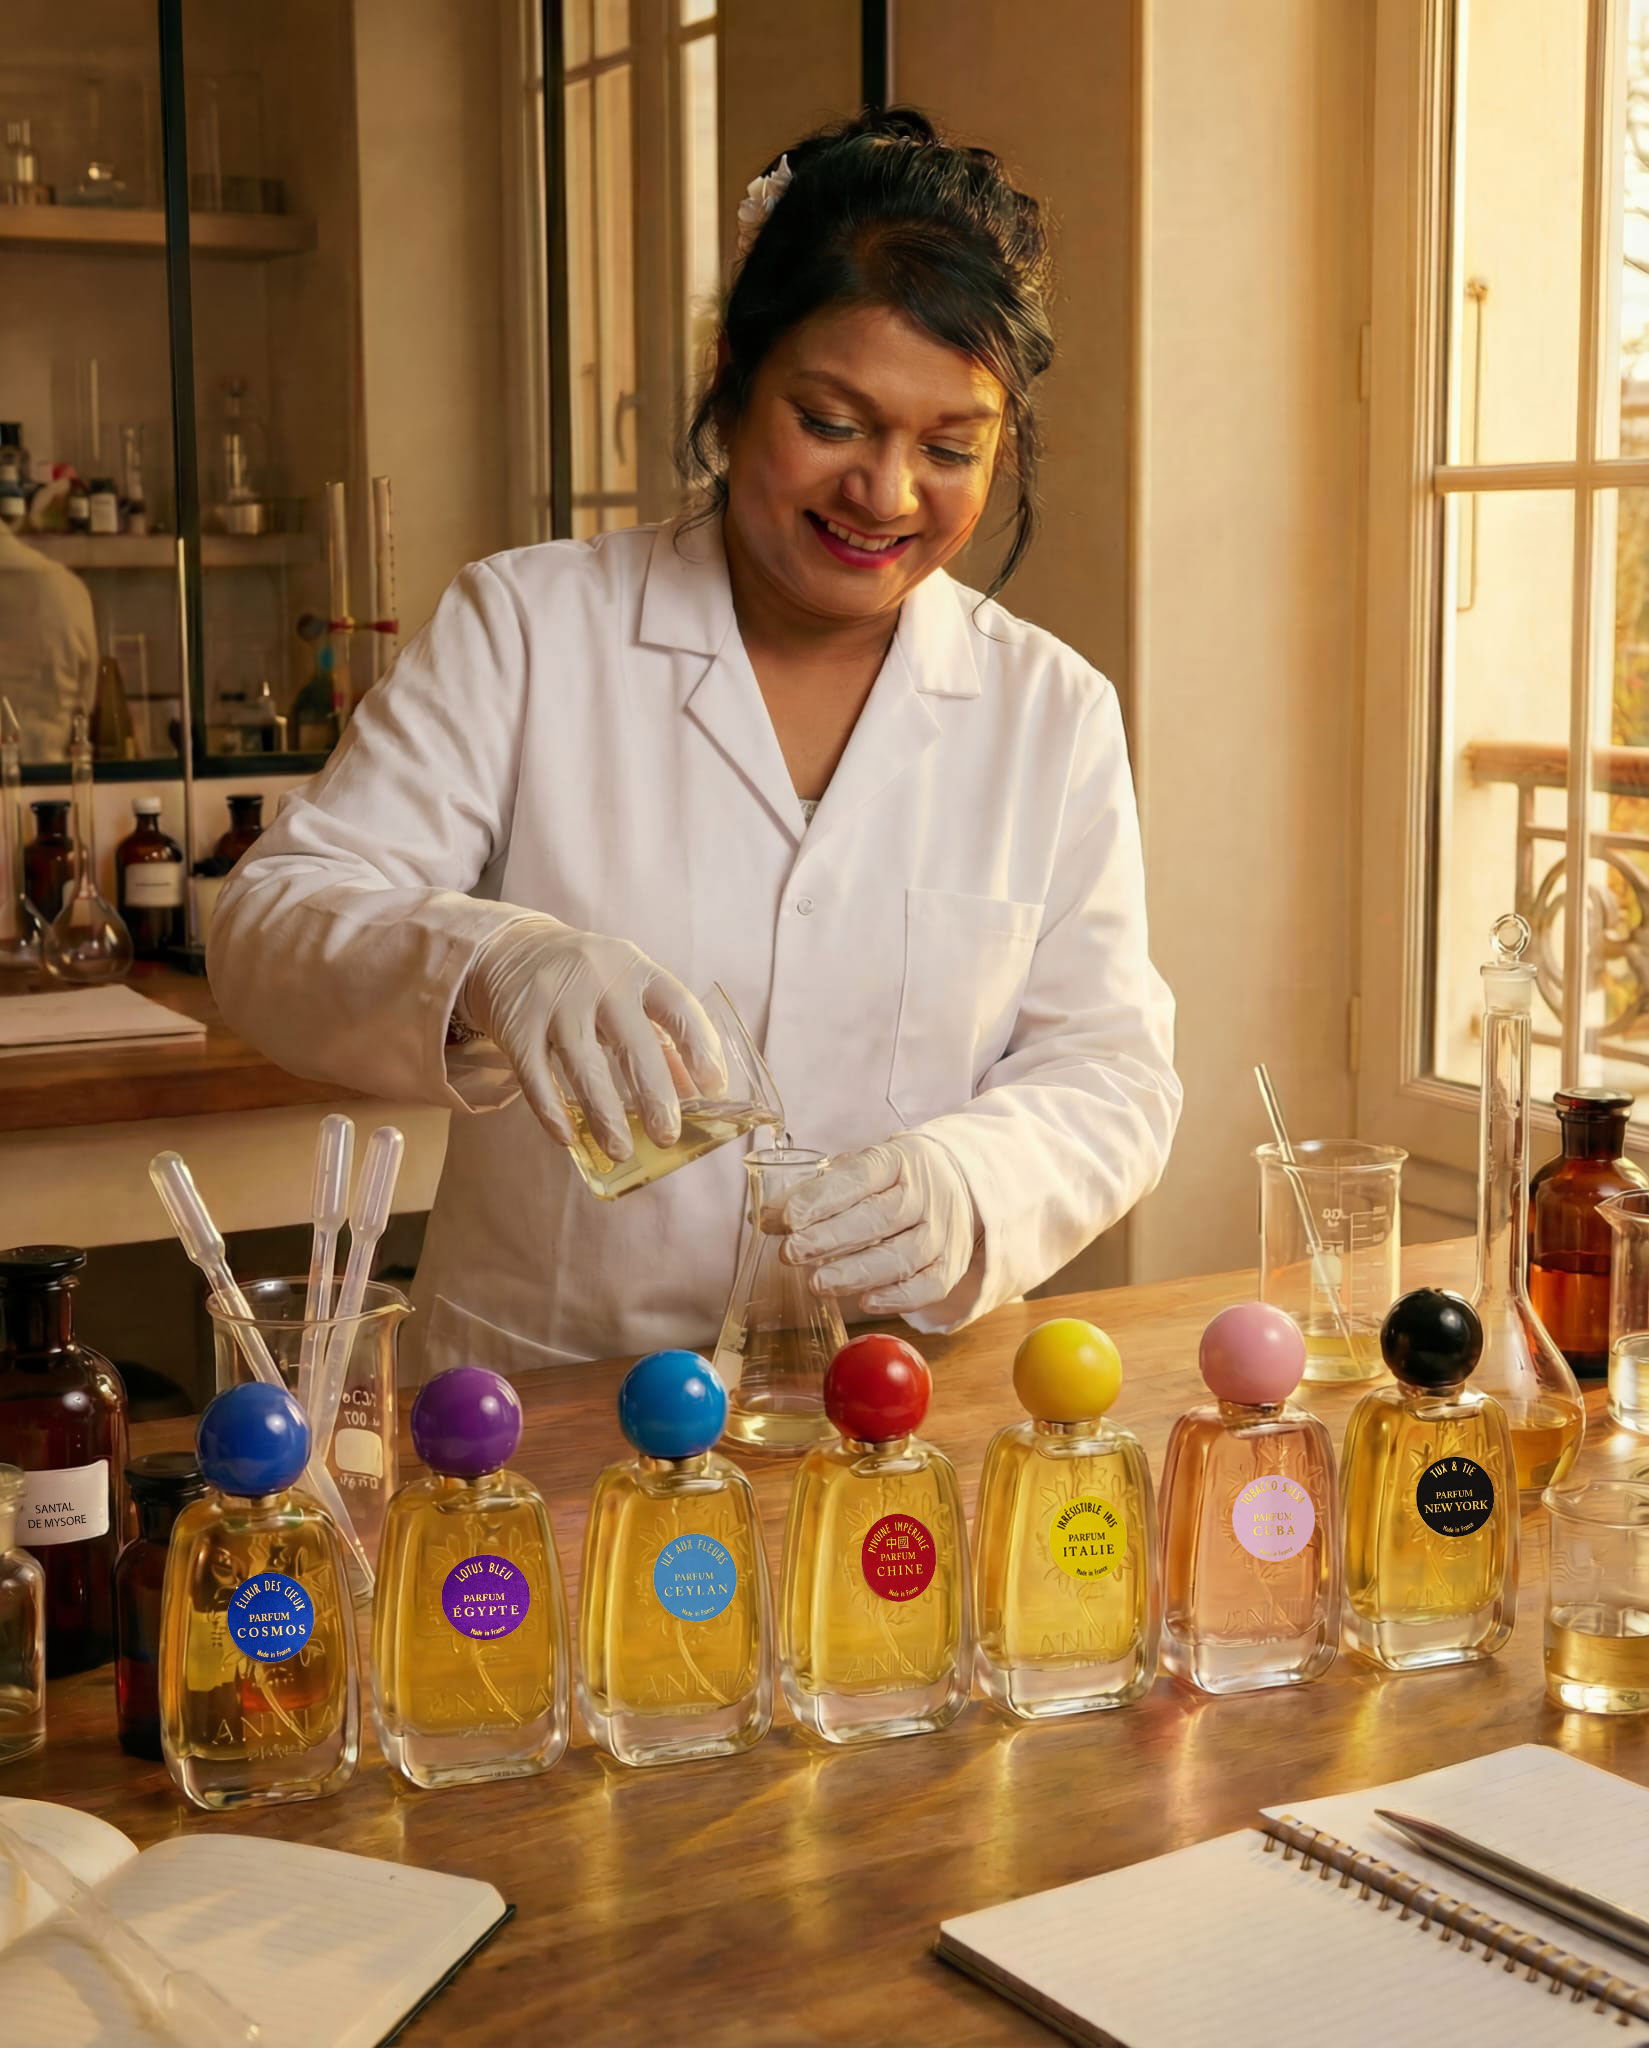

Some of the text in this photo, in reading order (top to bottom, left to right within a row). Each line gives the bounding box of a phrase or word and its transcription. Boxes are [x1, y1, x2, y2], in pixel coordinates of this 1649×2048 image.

[1430, 1461, 1476, 1478] TUX & TIE
[1241, 1480, 1305, 1505] TOBACCO SALSA
[1436, 1489, 1472, 1499] PARFUM
[35, 1502, 75, 1514] SANTAL
[1424, 1500, 1488, 1514] NEW YORK
[28, 1514, 86, 1528] DE MYSORE
[1057, 1502, 1117, 1530] IRRÉSISTIBLE IRIS
[1254, 1512, 1292, 1522] PARFUM
[1253, 1525, 1296, 1536] CUBA
[868, 1522, 929, 1553] PIVOINE IMPÉRIALE
[1068, 1532, 1105, 1542] PARFUM
[661, 1540, 728, 1567] ILE AUX FLEURS
[880, 1552, 916, 1561] PARFUM
[1064, 1544, 1114, 1557] ITALIE
[455, 1562, 513, 1582] LOTUS BLEU
[877, 1564, 923, 1576] CHINE
[674, 1572, 714, 1581] PARFUM
[235, 1580, 306, 1612] ÉLIXIR DES CIEUX
[664, 1584, 728, 1596] CEYLAN
[464, 1593, 505, 1602] PARFUM
[249, 1612, 290, 1622] PARFUM
[453, 1605, 519, 1617] ÉGYPTE
[237, 1624, 306, 1638] COSMOS
